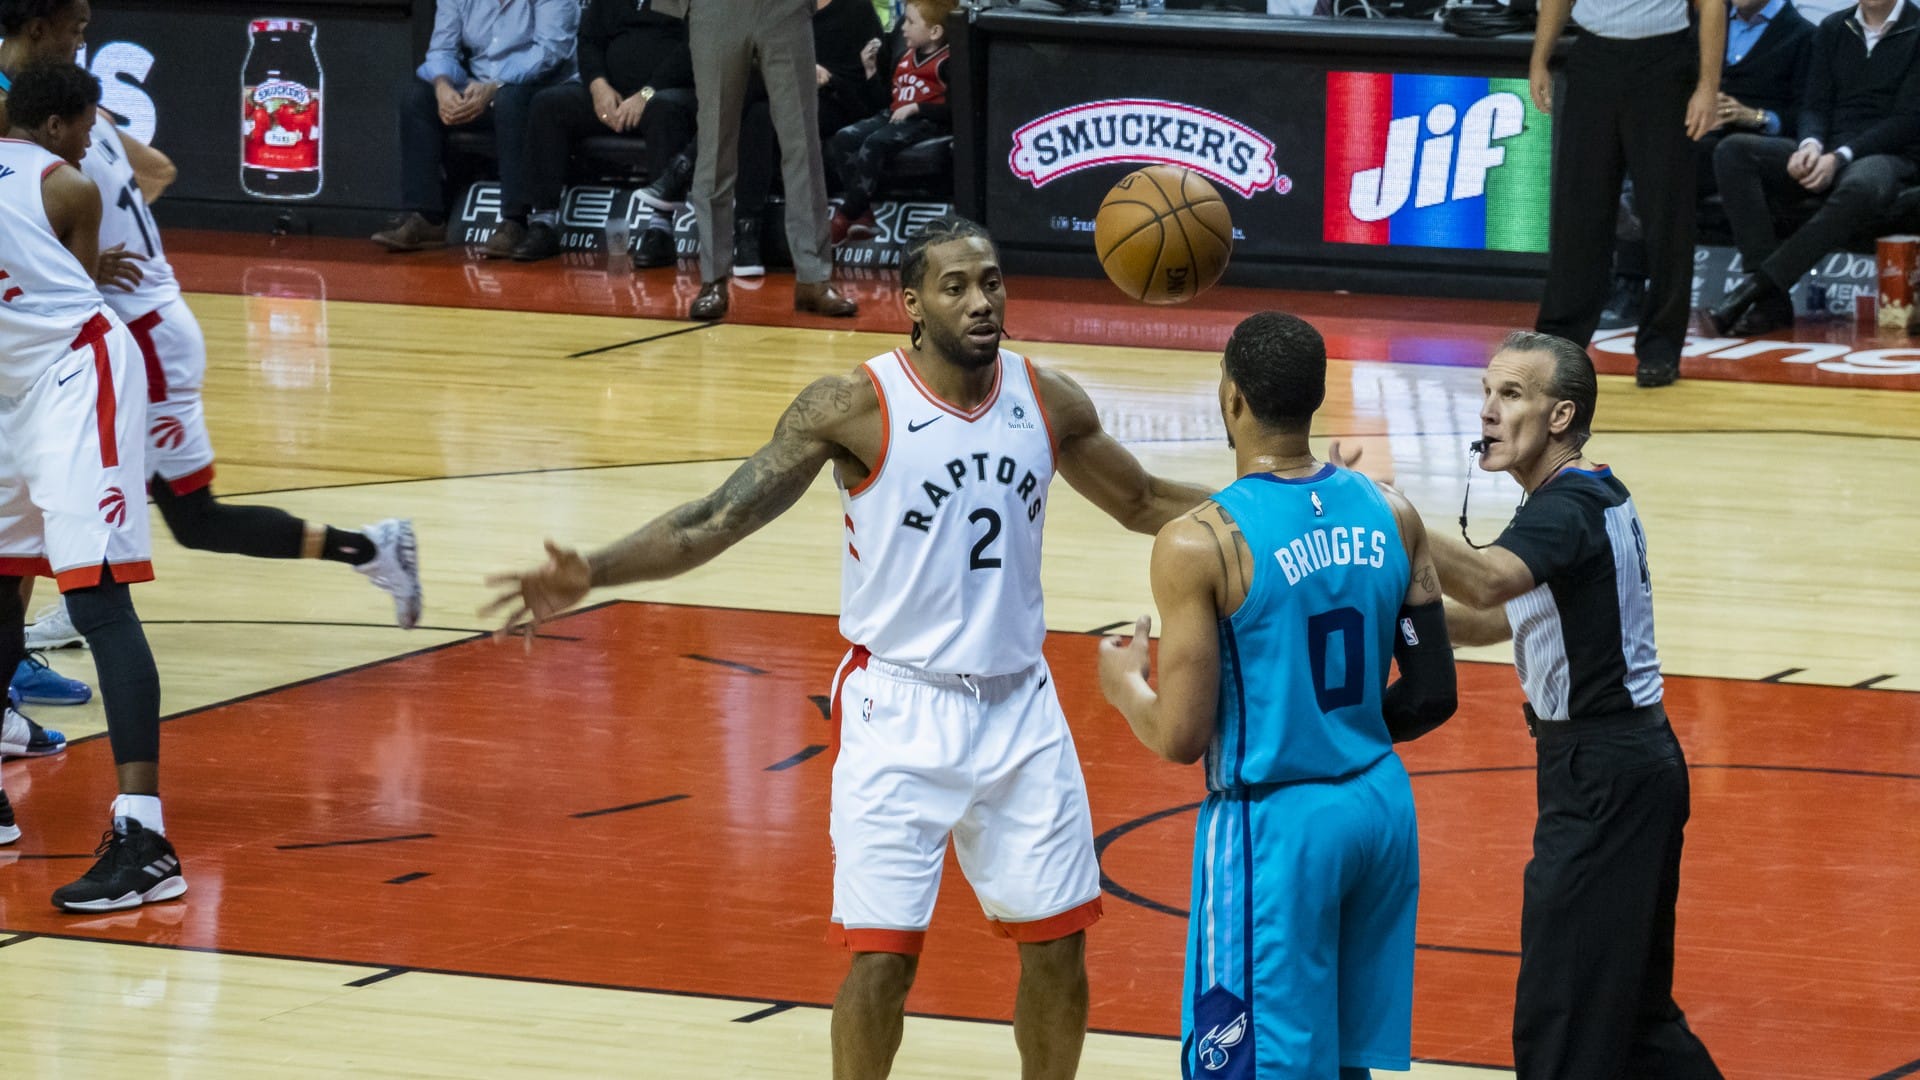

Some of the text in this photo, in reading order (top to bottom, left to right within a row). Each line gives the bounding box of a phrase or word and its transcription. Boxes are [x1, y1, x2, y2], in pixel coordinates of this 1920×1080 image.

[1032, 112, 1257, 175] SMUCKER'S
[1348, 91, 1525, 222] Jif
[465, 227, 497, 244] FIN
[560, 232, 599, 249] AGIC.
[835, 247, 900, 265] YOUR MA
[1008, 421, 1021, 430] Sun
[902, 452, 1042, 533] RAPTORS
[967, 507, 1002, 571] 2
[1274, 526, 1386, 586] BRIDGES
[1308, 606, 1365, 715] 0
